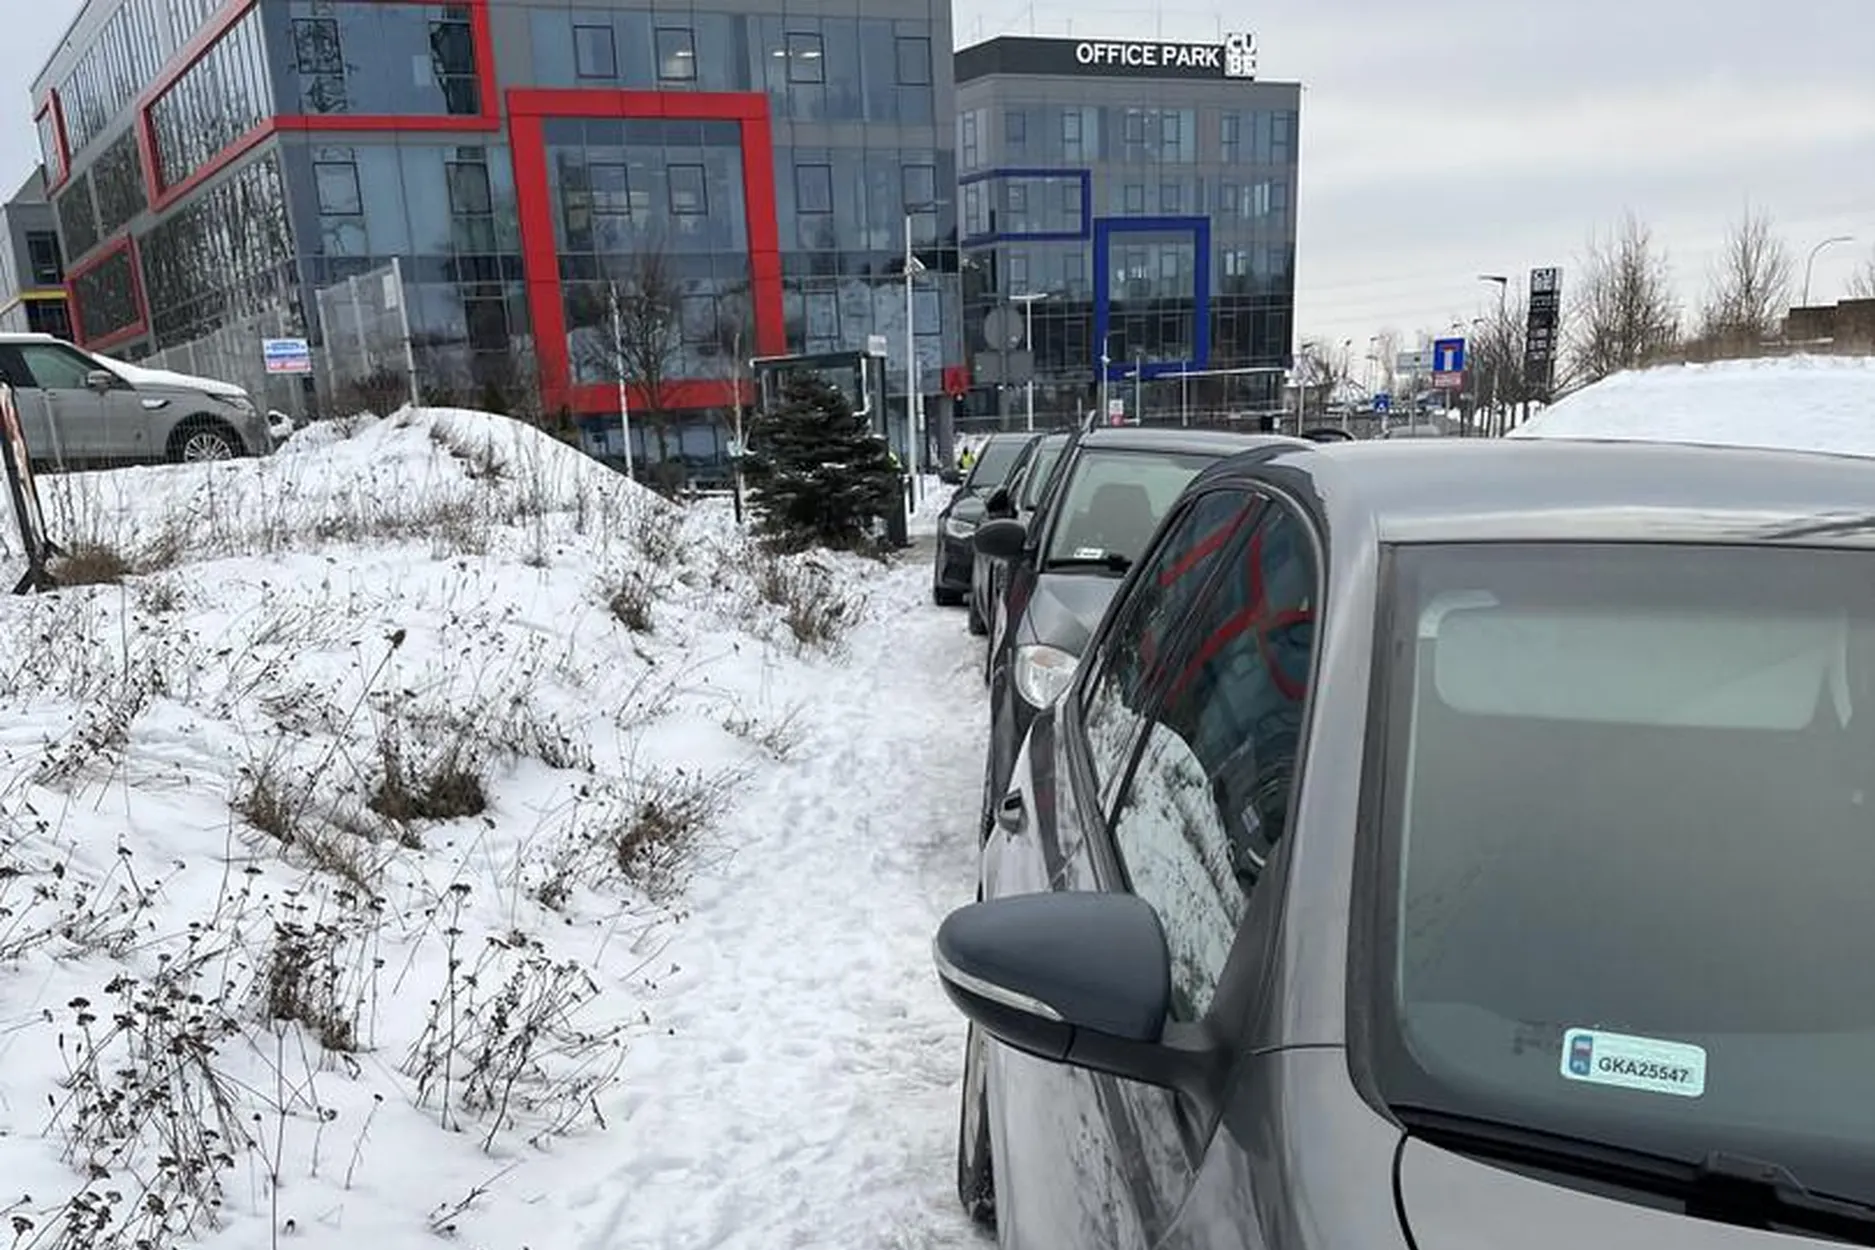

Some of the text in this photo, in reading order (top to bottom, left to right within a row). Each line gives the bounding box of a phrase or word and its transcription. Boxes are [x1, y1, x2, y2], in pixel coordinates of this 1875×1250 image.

[1076, 43, 1221, 67] OFFICE PARK
[1226, 34, 1257, 53] CU
[1599, 1057, 1689, 1083] GKA25547
